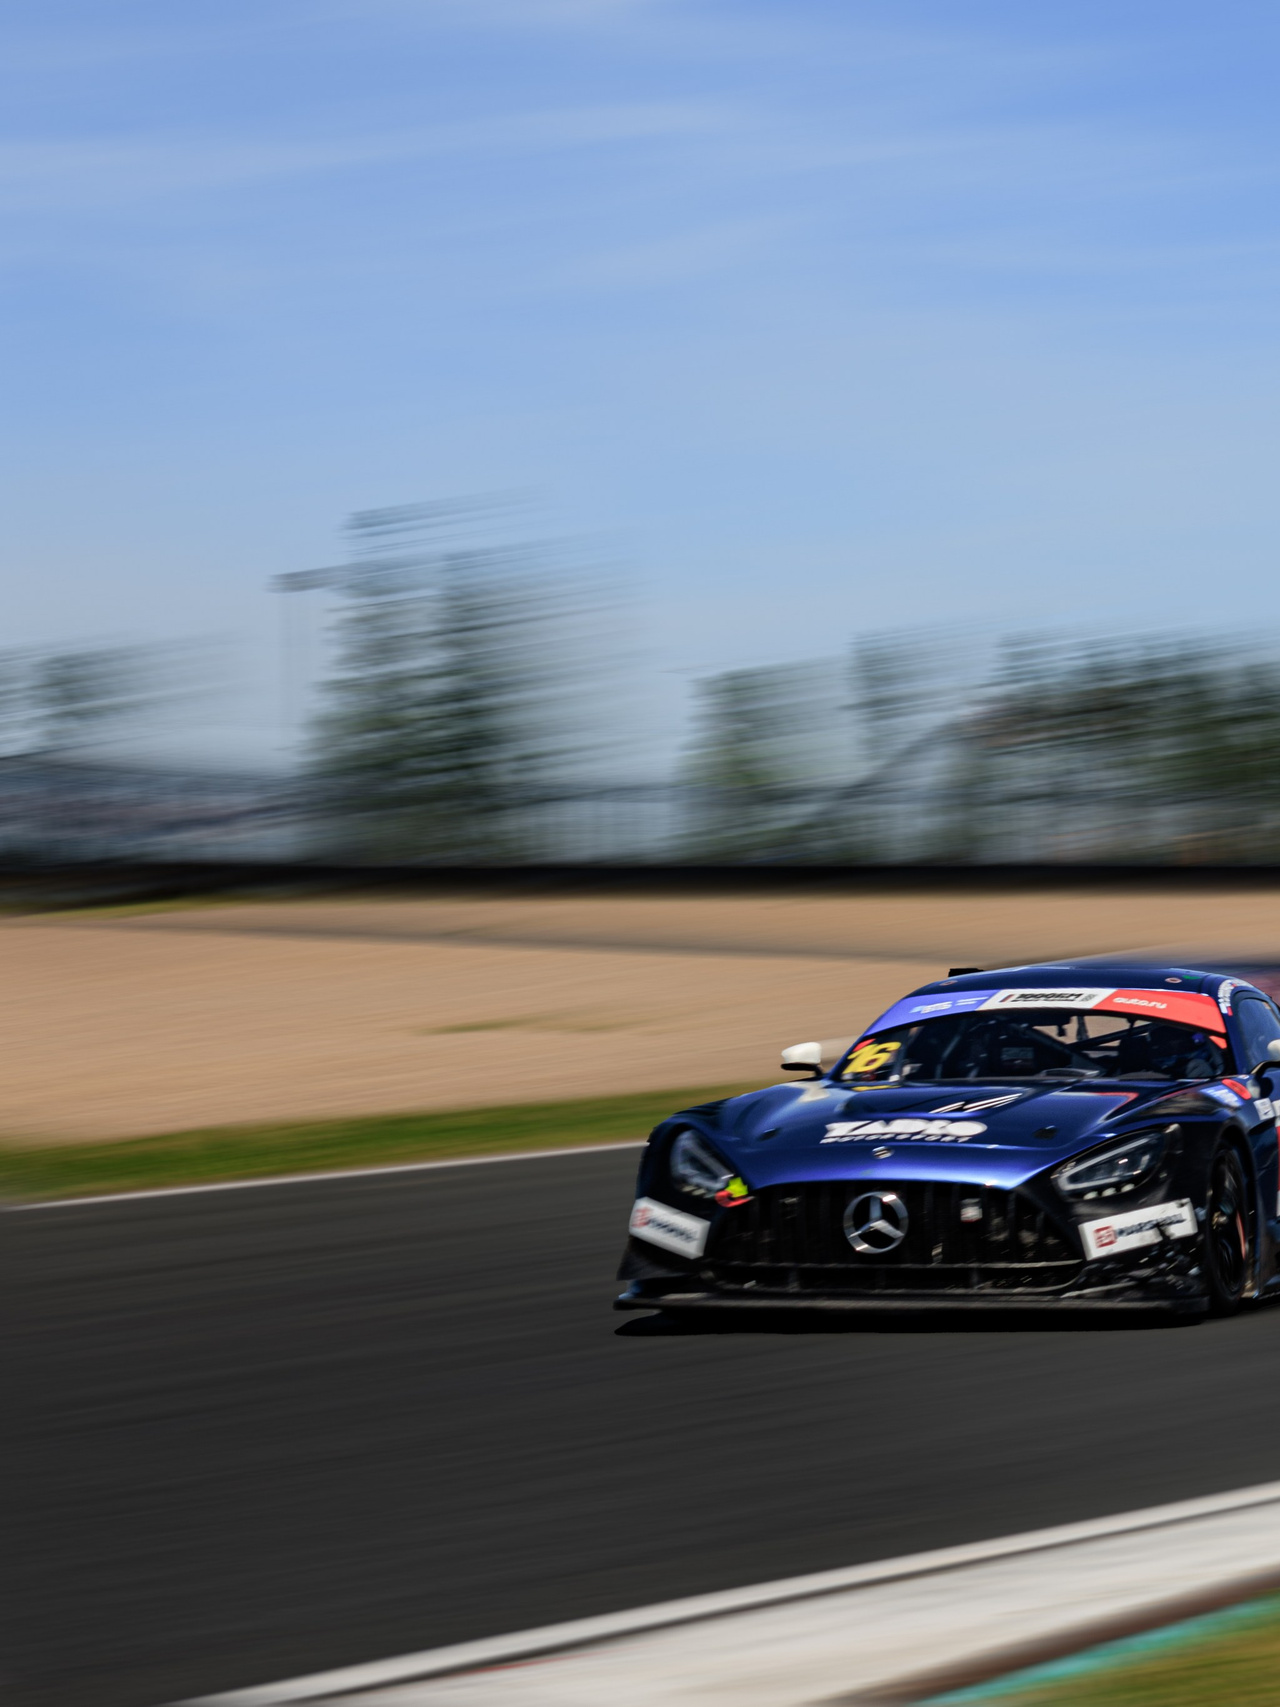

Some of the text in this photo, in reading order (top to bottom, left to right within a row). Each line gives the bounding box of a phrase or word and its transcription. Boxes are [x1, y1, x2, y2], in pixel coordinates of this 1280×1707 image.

[1112, 997, 1168, 1010] auto.ru
[842, 1041, 902, 1075] 16
[819, 1133, 972, 1144] MOTORSPORT
